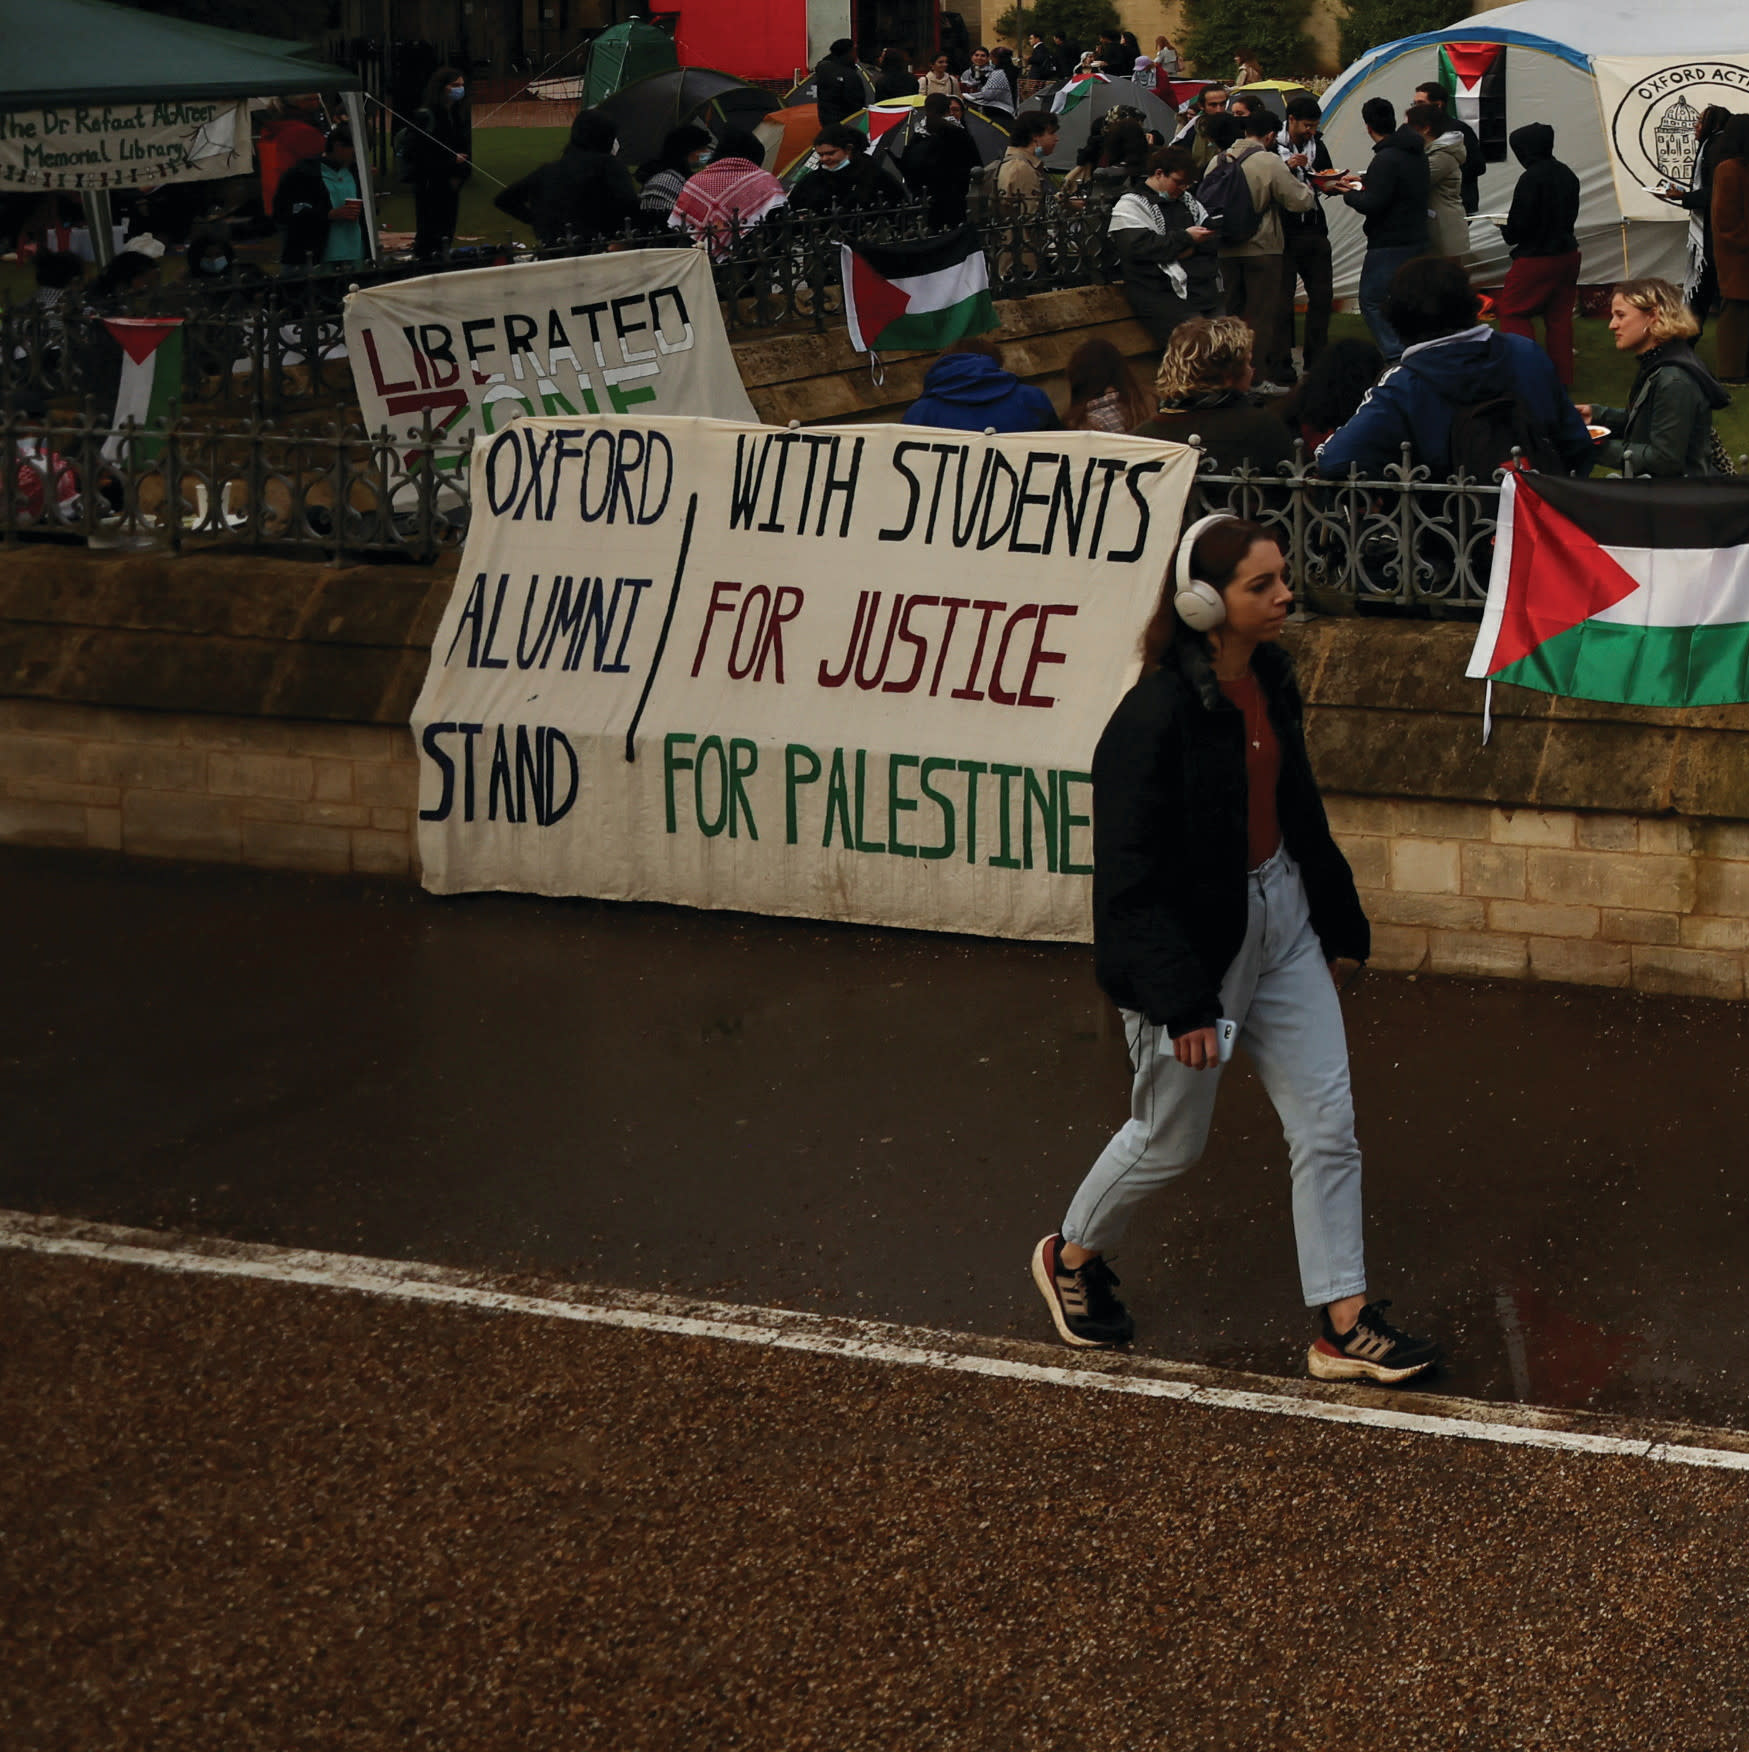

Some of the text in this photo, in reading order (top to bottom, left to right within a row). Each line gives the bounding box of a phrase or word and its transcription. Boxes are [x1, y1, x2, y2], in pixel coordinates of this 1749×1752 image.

[76, 107, 146, 133] Refaat
[1638, 68, 1705, 100] OXFORD
[23, 138, 184, 169] Memorial Library
[361, 285, 695, 396] LIBERATED
[486, 428, 673, 525] OXFORD
[730, 434, 1165, 564] WITH STUDENTS
[444, 572, 653, 674] ALUMNI
[690, 580, 1079, 709] FOR JUSTICE
[419, 721, 580, 827] STAND
[663, 732, 1095, 875] FOR PALESTINE
